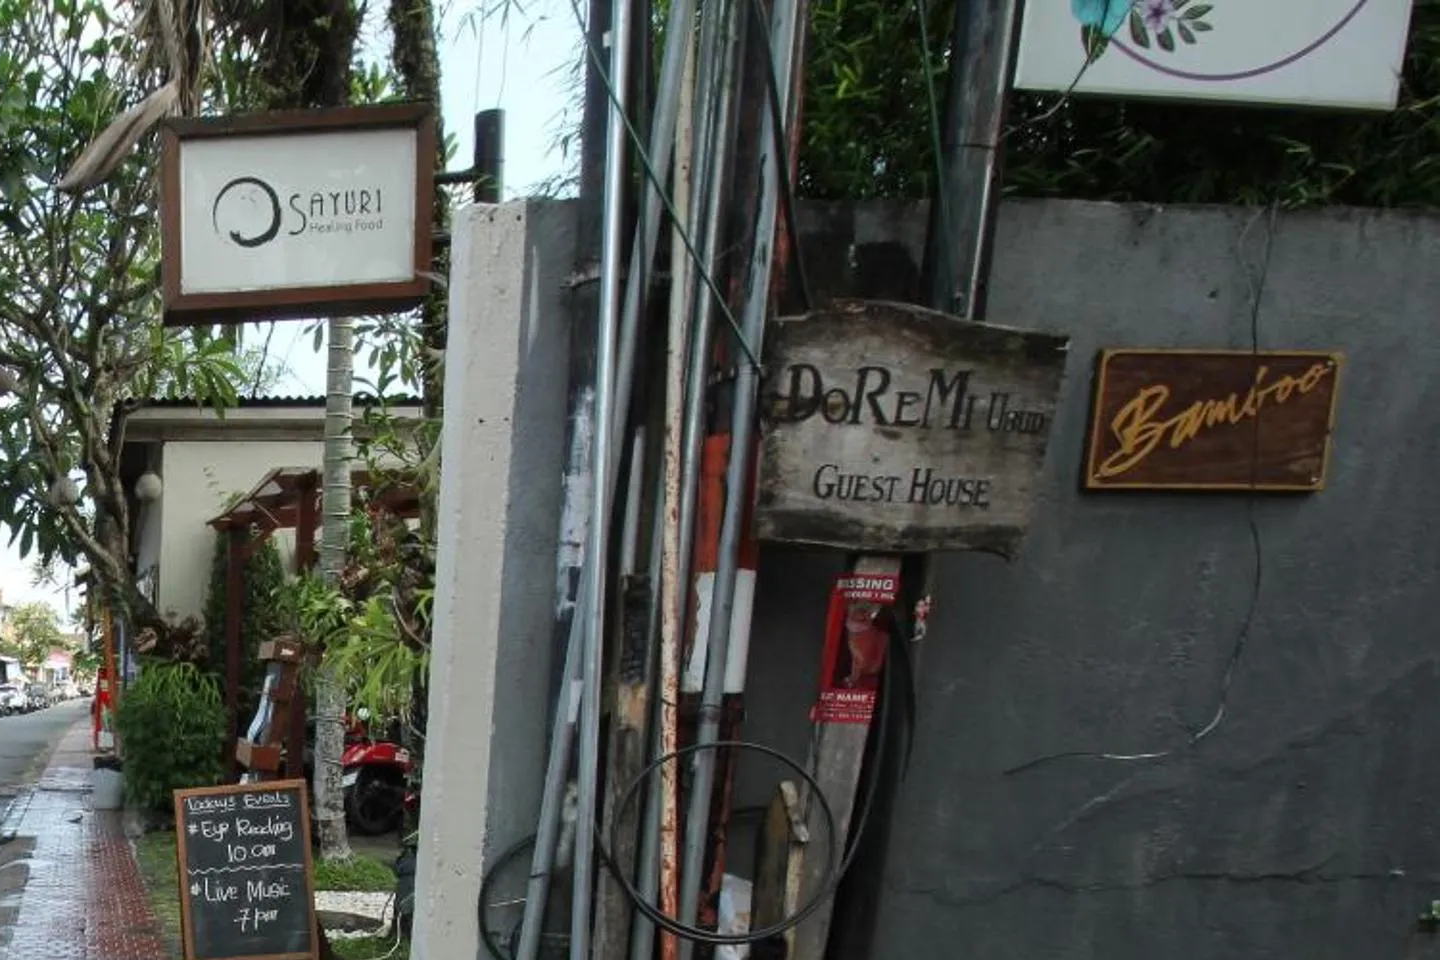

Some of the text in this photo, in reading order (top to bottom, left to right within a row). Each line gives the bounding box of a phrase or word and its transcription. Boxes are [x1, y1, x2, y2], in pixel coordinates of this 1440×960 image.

[288, 187, 382, 235] SAYURI
[355, 219, 383, 233] Food
[1098, 366, 1331, 479] Bamboo
[813, 463, 990, 508] GUEST HOUSE
[246, 877, 291, 903] Music
